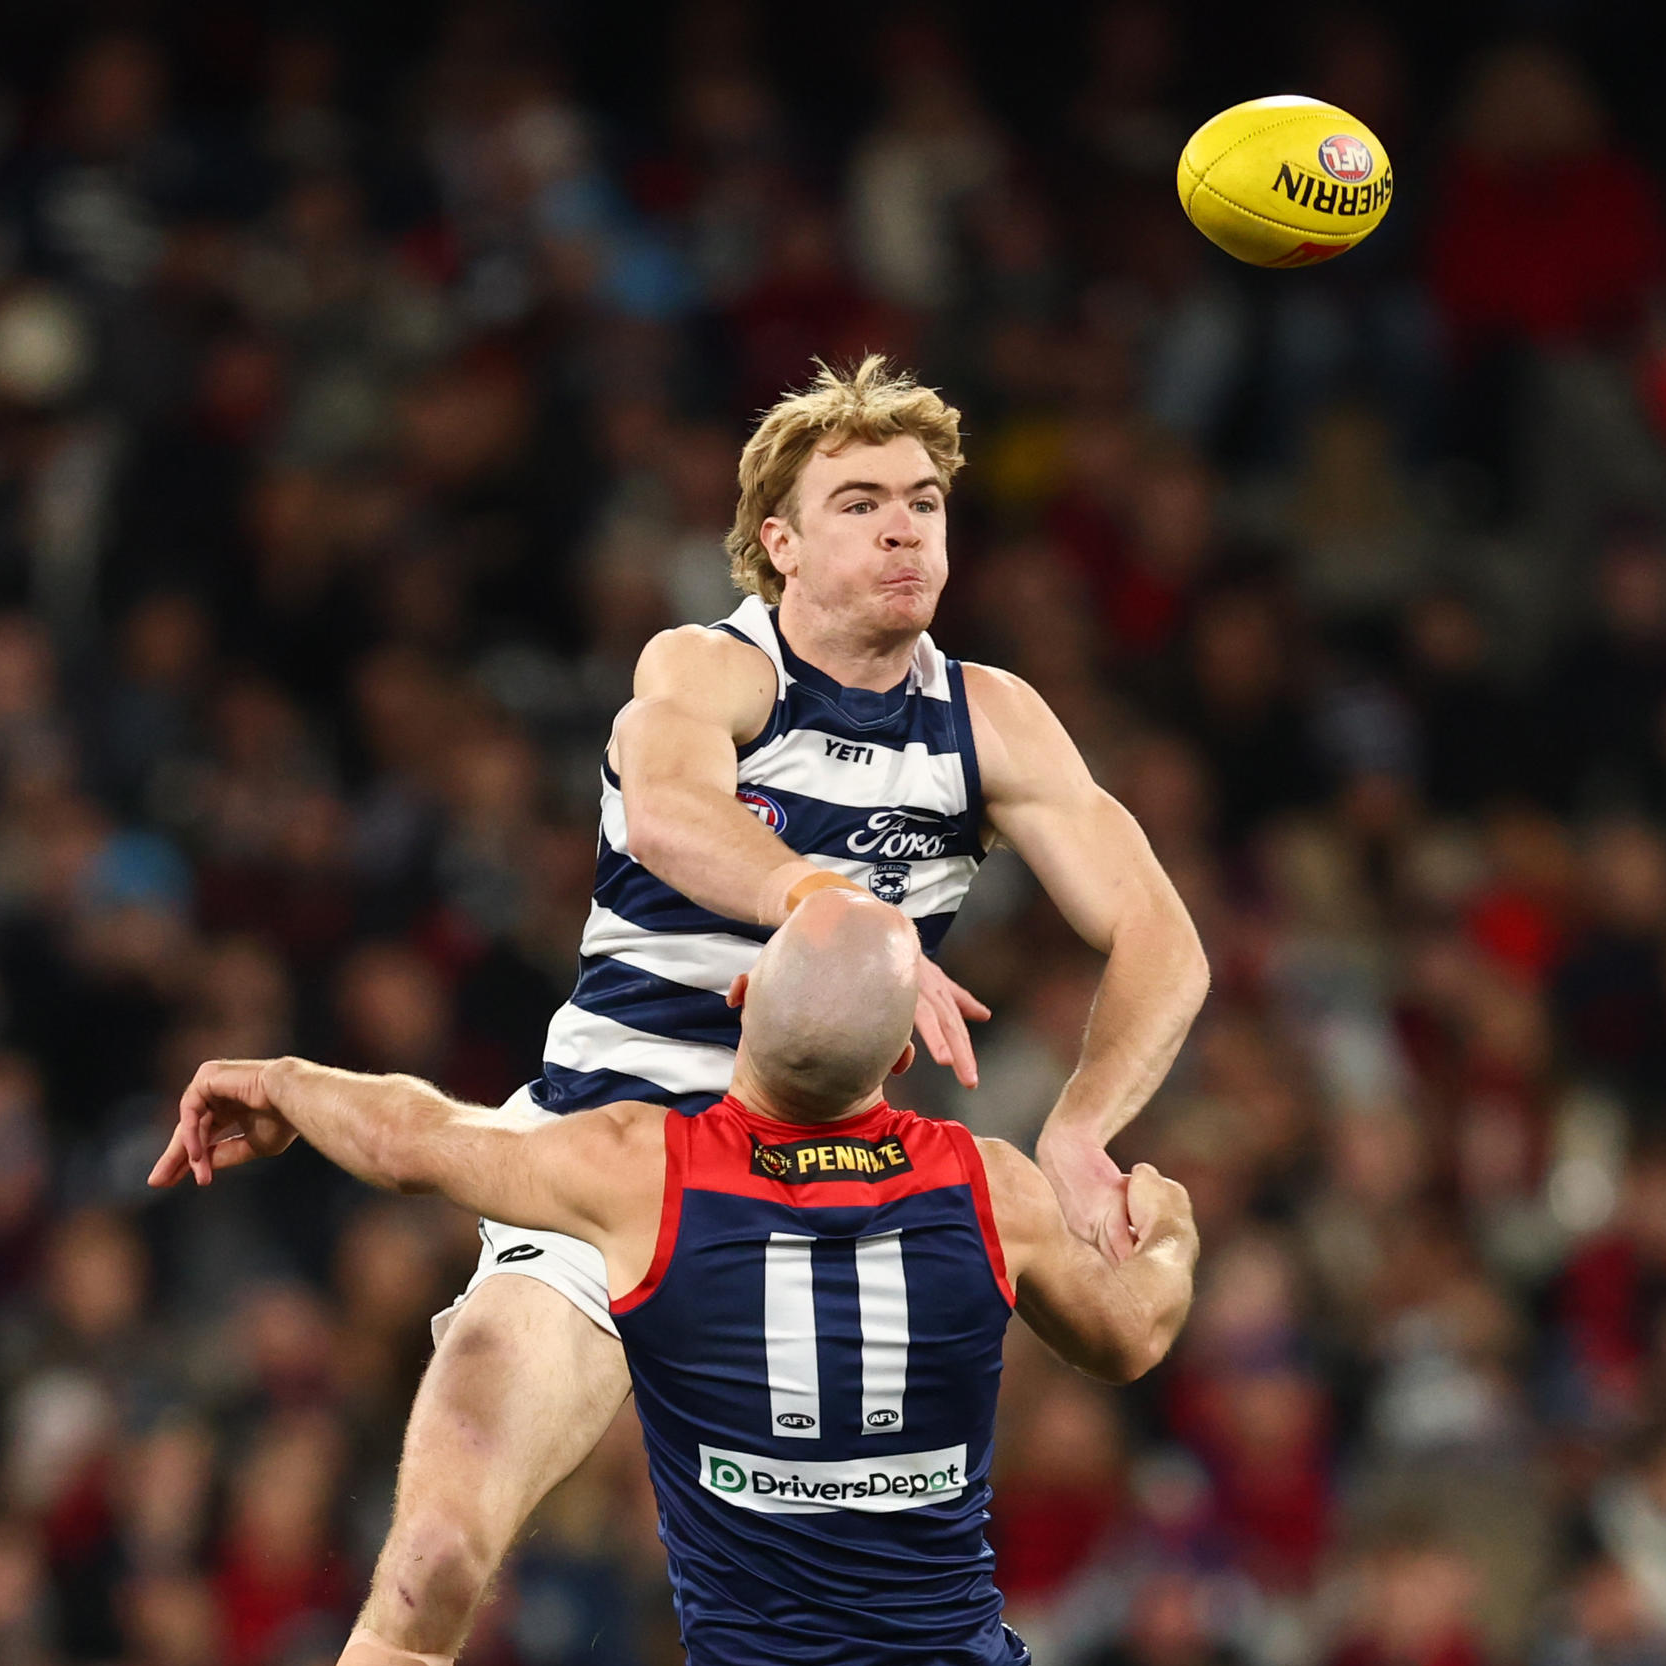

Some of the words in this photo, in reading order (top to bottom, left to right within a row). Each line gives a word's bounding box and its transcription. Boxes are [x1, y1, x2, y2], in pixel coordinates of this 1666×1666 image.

[1322, 144, 1367, 172] AFL
[1271, 162, 1393, 217] SHERRIN
[823, 738, 873, 765] YETI
[846, 810, 958, 858] Ford
[765, 1228, 910, 1439] 11
[779, 1414, 813, 1427] AFL
[868, 1410, 898, 1424] AFL
[752, 1463, 960, 1501] DriversDepot
